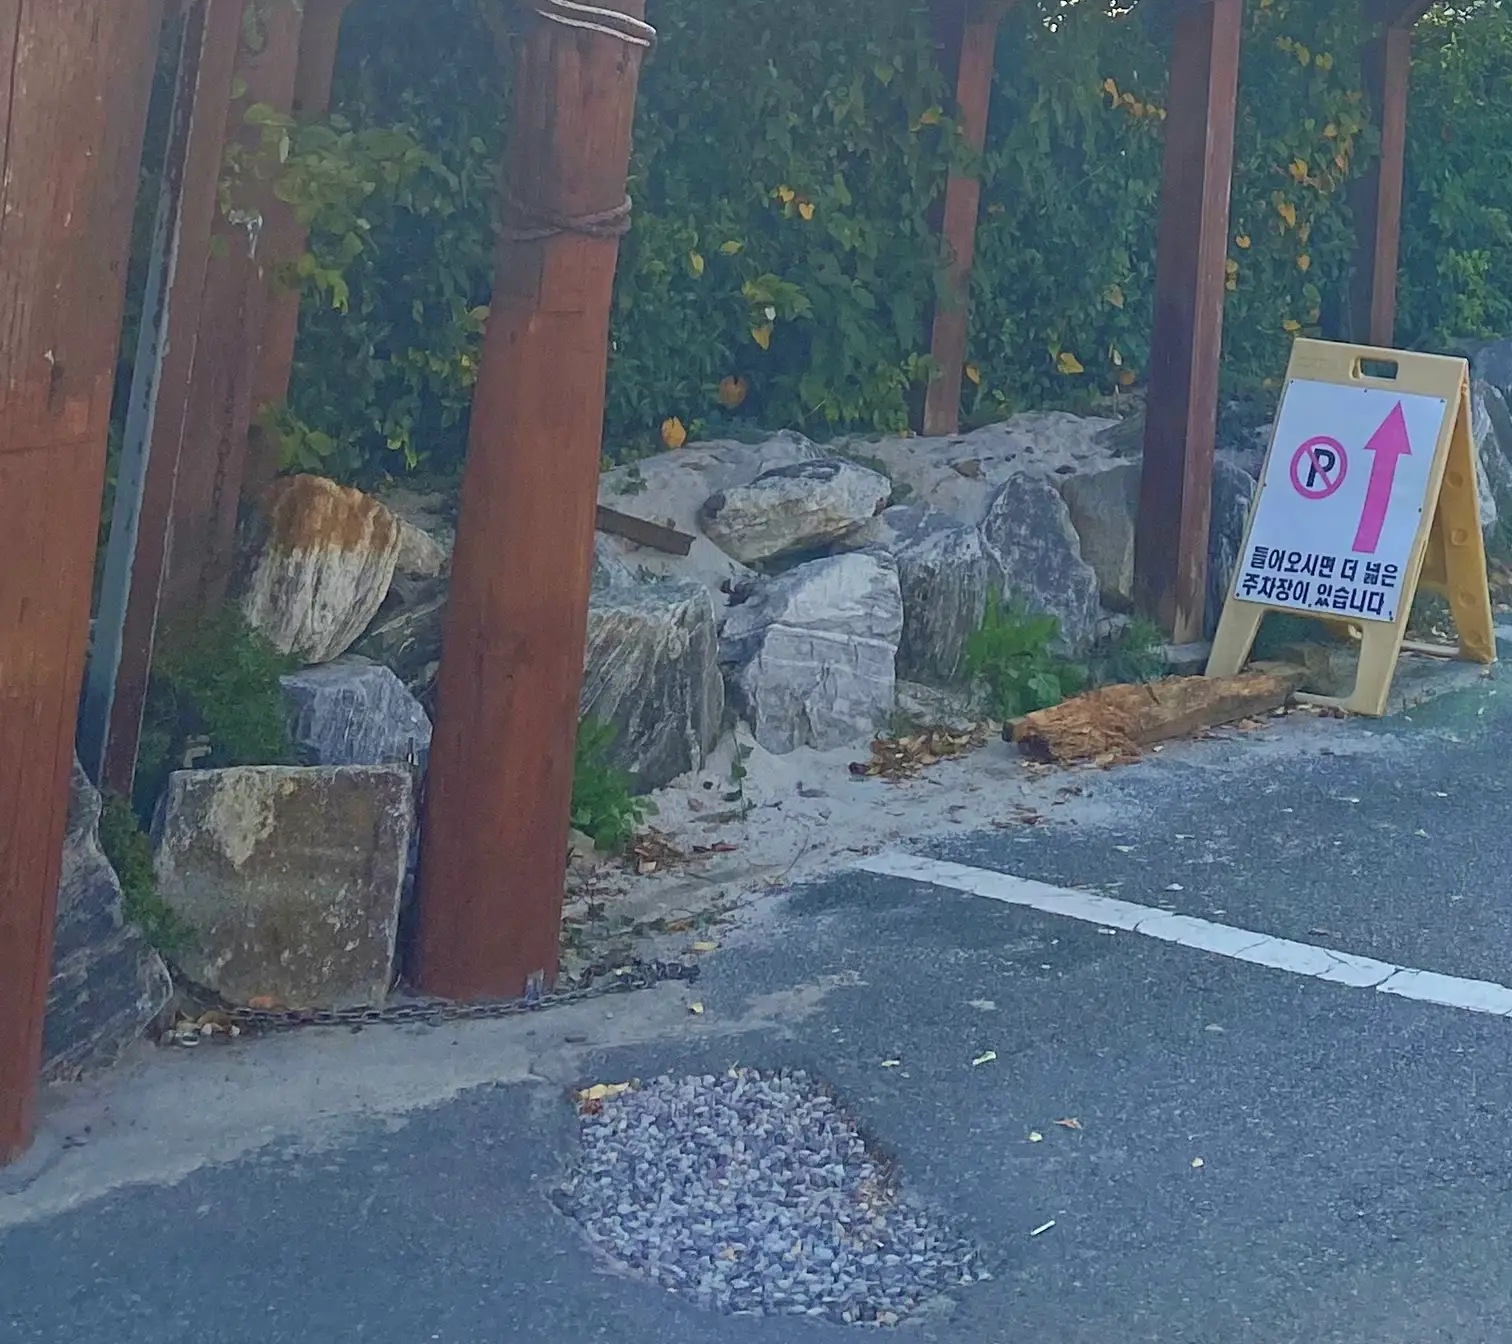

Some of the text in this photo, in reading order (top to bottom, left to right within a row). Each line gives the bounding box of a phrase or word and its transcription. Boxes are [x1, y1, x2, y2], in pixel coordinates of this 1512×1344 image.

[1250, 545, 1399, 588] 들어오시면 더 넓은
[1242, 572, 1385, 615] 주차장이 있습니다
